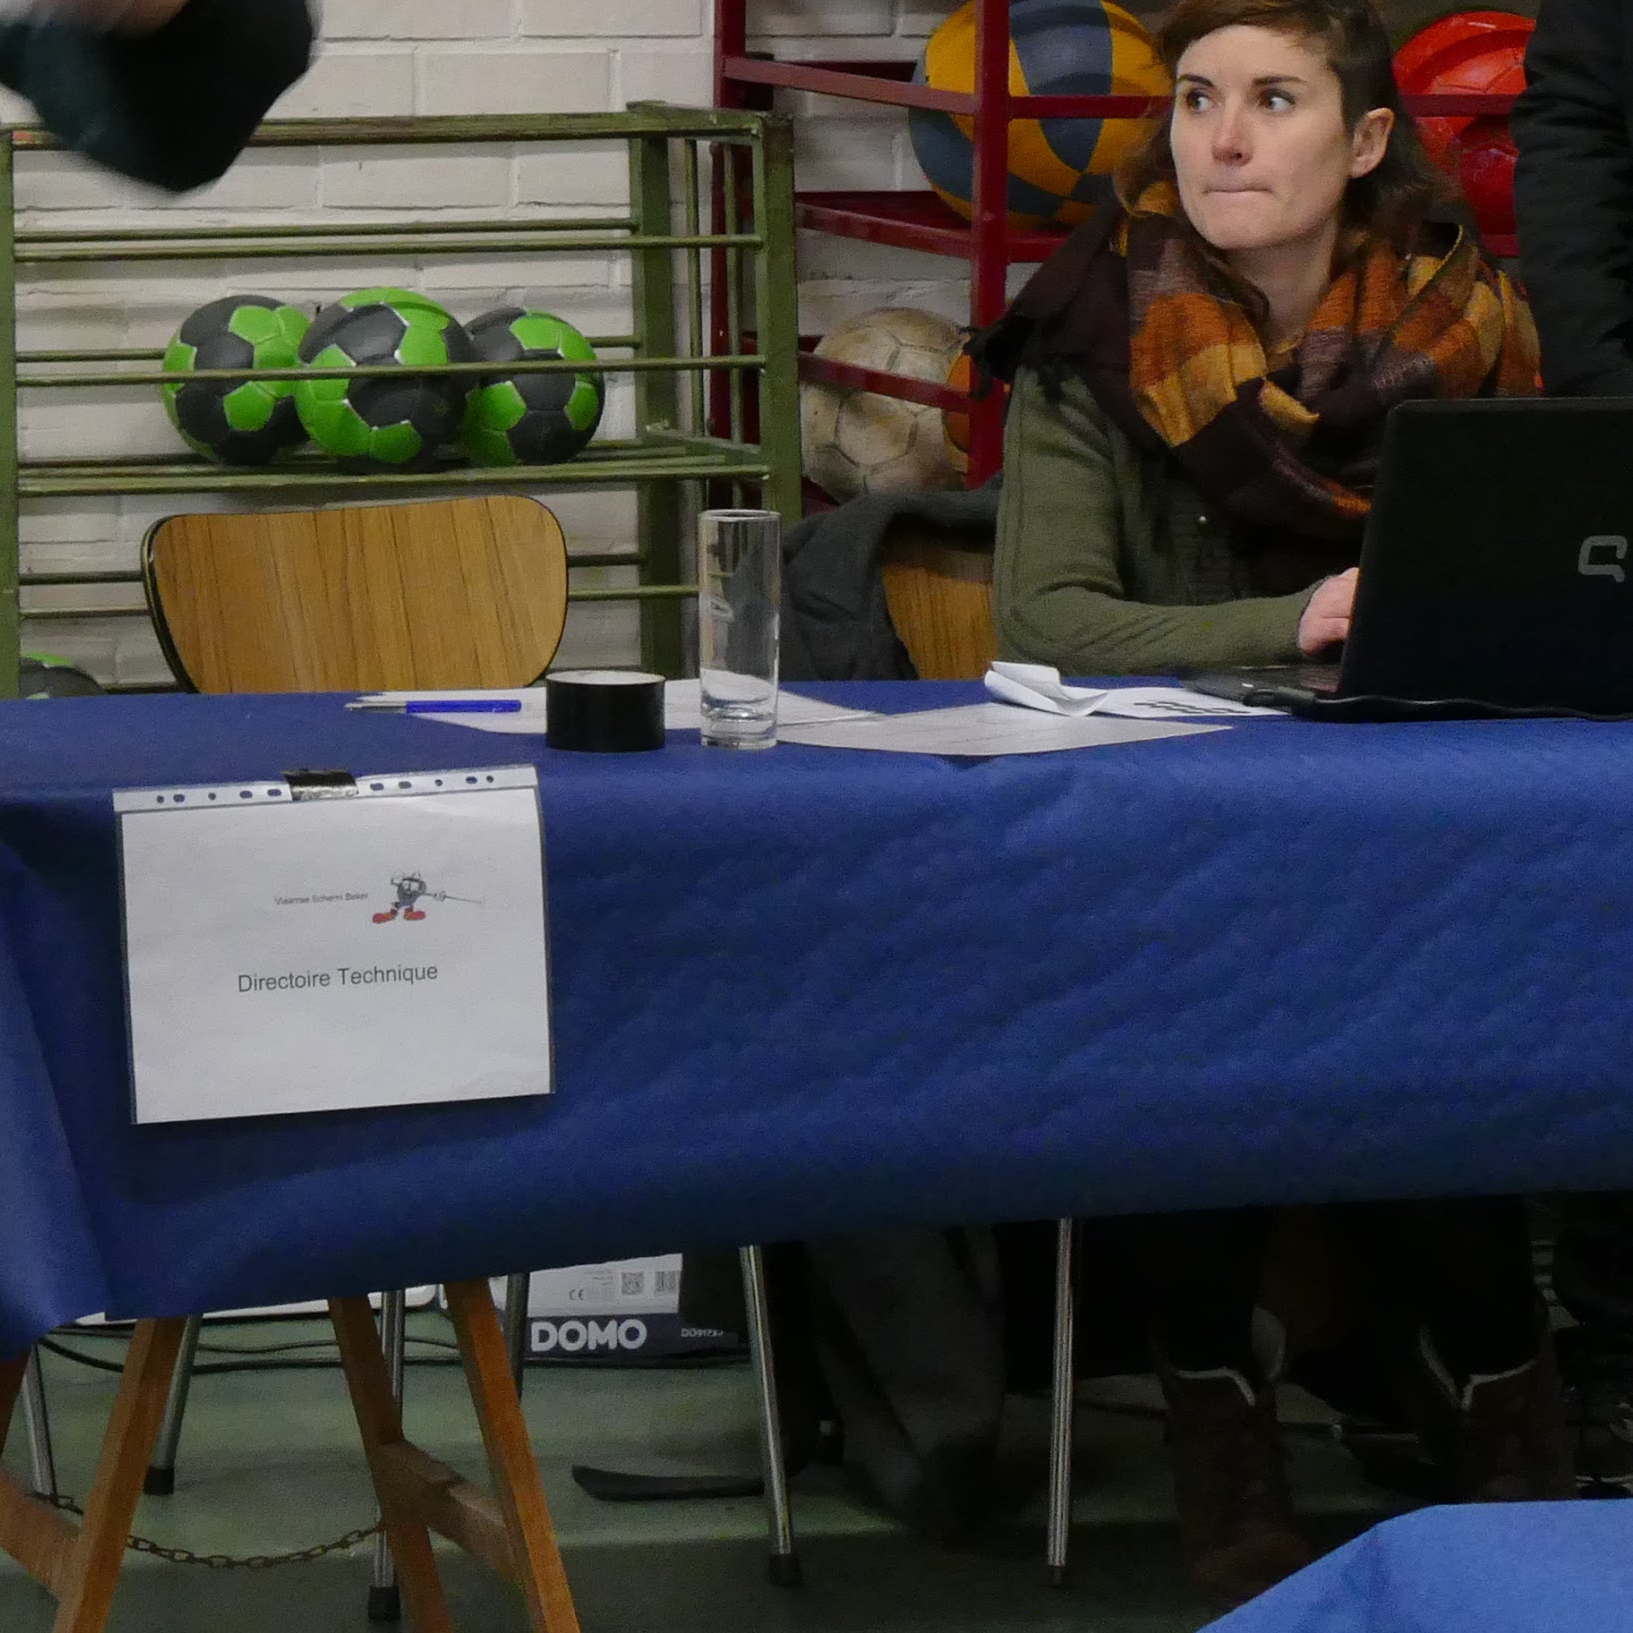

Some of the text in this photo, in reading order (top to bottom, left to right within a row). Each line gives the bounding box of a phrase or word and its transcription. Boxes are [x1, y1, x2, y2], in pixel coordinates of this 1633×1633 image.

[238, 965, 439, 993] Directoire Technique
[531, 1319, 647, 1352] DOMO
